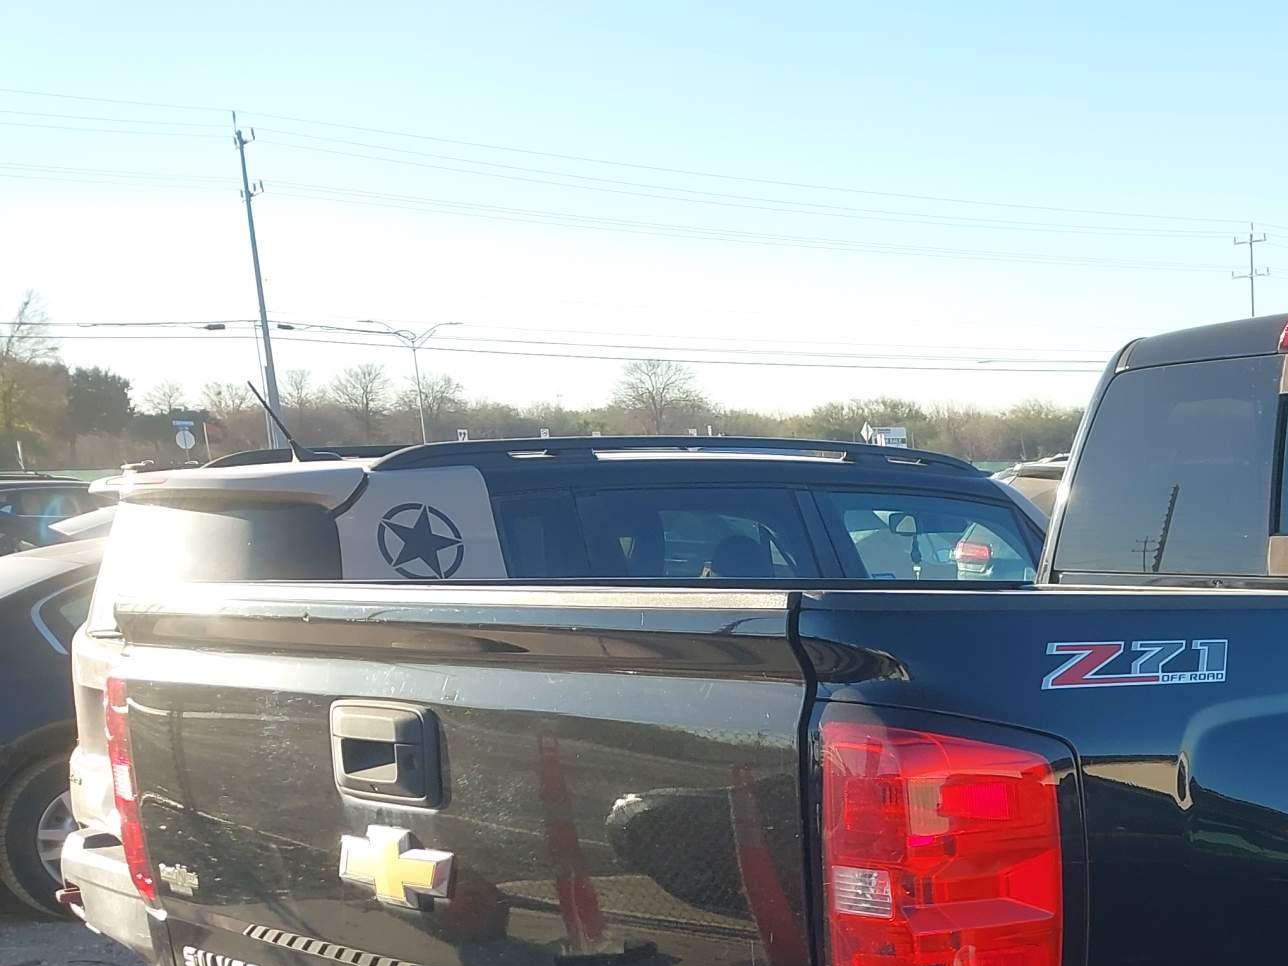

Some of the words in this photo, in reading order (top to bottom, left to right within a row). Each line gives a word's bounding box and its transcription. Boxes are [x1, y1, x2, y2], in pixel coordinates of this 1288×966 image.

[1041, 639, 1228, 690] Z71
[1161, 673, 1187, 683] OFF
[1190, 672, 1224, 681] ROAD
